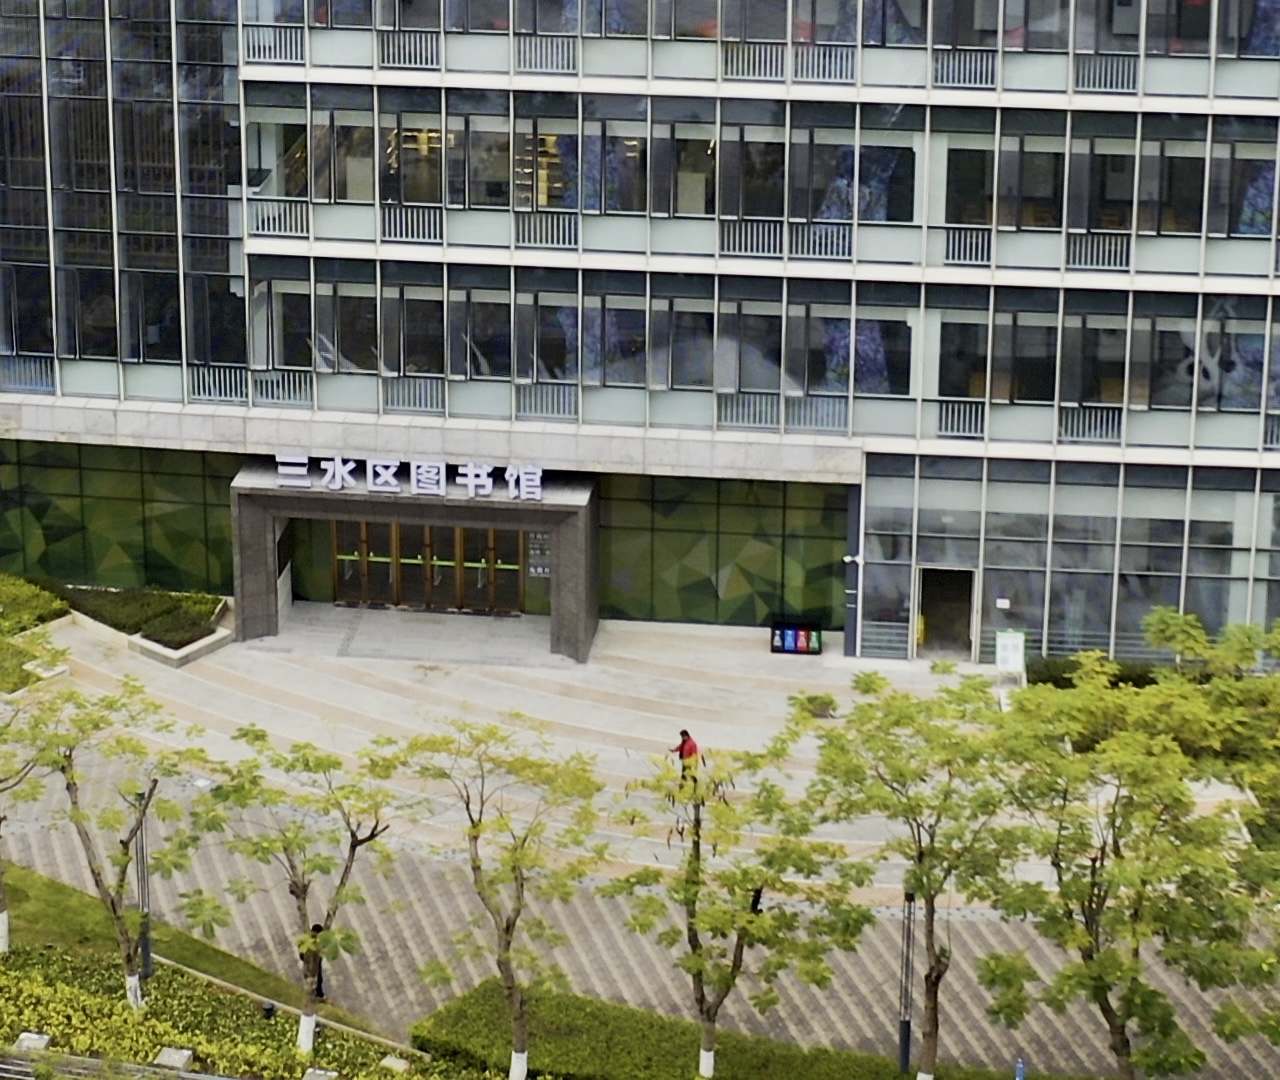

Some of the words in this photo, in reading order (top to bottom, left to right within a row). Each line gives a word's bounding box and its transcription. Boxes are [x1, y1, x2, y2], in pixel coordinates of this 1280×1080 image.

[275, 455, 543, 501] 三水区图书馆
